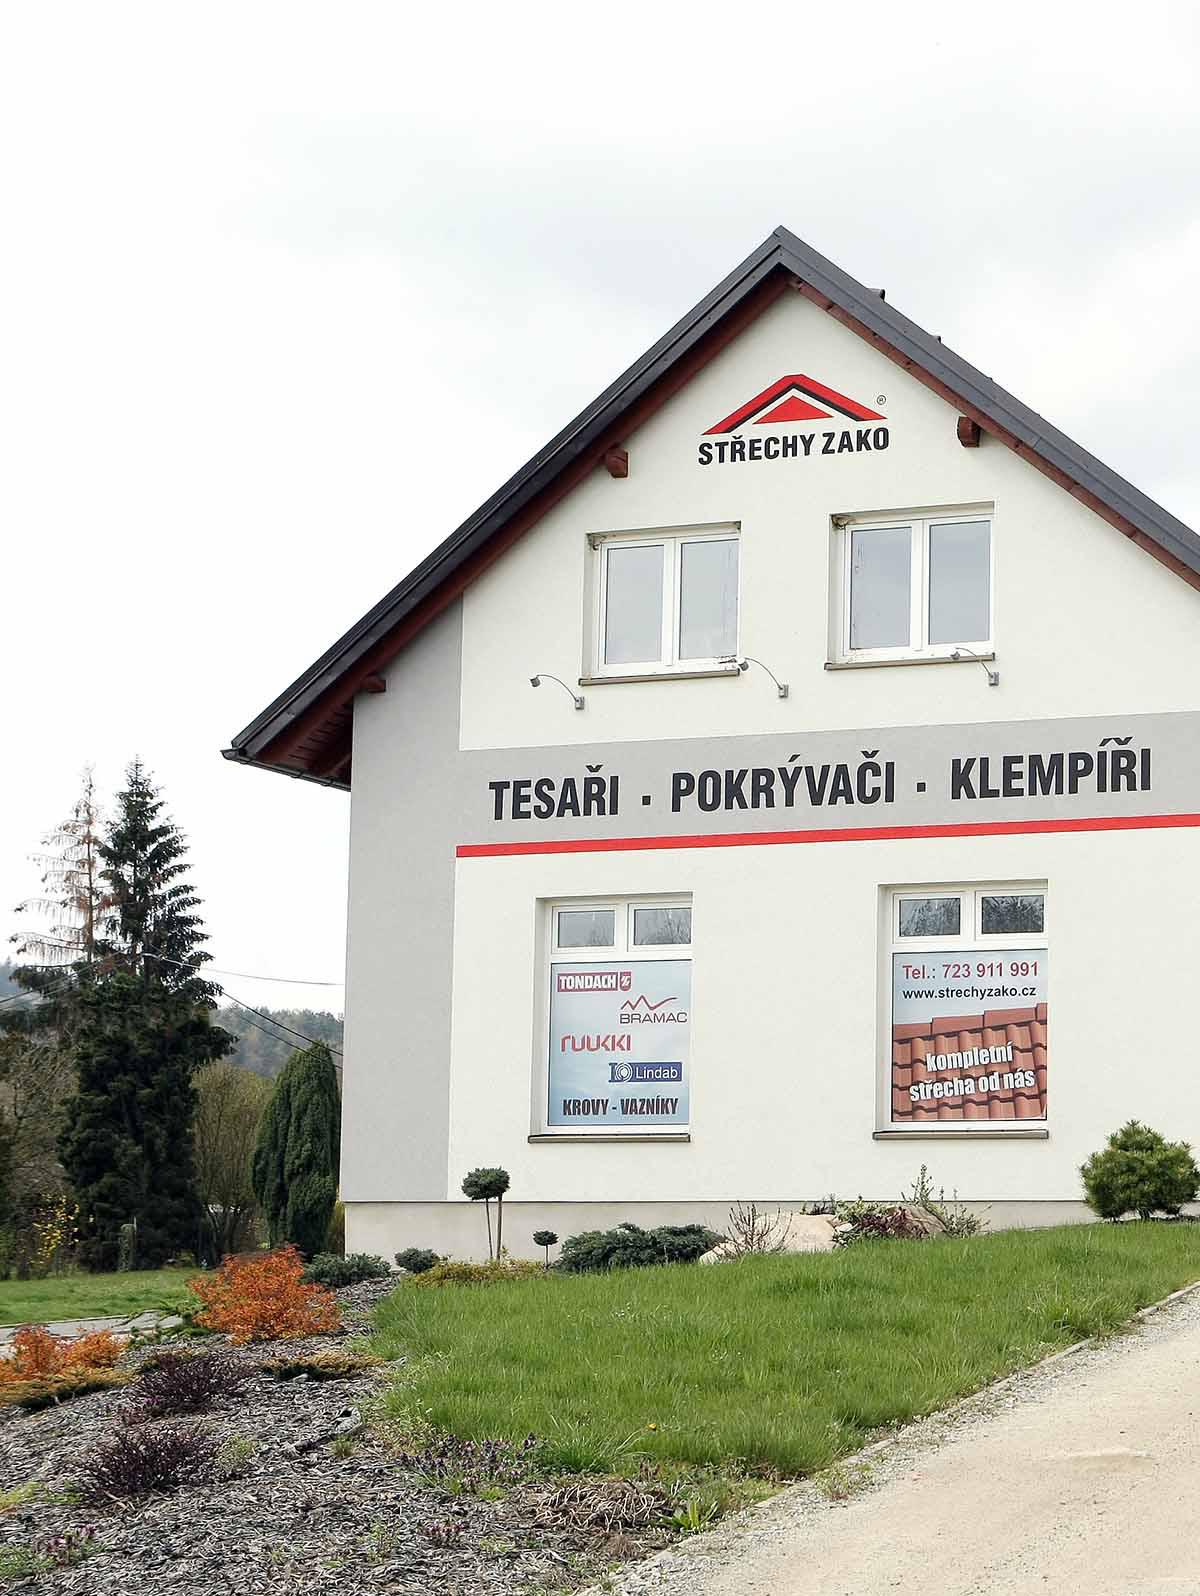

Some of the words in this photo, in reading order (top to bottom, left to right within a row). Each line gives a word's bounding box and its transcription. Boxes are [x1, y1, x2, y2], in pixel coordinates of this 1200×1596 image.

[698, 434, 816, 466] STŘECHY
[821, 427, 890, 455] ZAKO
[488, 764, 619, 821] TESAŘI
[671, 754, 895, 812] POKRÝVAČI
[951, 736, 1151, 800] KLEMPÍŘI
[902, 964, 936, 980] Tel.:
[942, 963, 971, 979] 723
[976, 962, 1003, 978] 911
[1010, 961, 1038, 977] 991
[559, 974, 617, 990] TONDACH
[902, 984, 1037, 1001] www.strechyzako.cz
[619, 1012, 688, 1024] BRAMAC
[926, 1041, 1014, 1072] kompletní
[635, 1066, 678, 1079] Lindab
[909, 1078, 976, 1102] střecha
[978, 1072, 1000, 1093] od
[1004, 1068, 1035, 1089] nás
[562, 1098, 609, 1116] KROVY
[620, 1095, 679, 1115] VAZNÍKY
